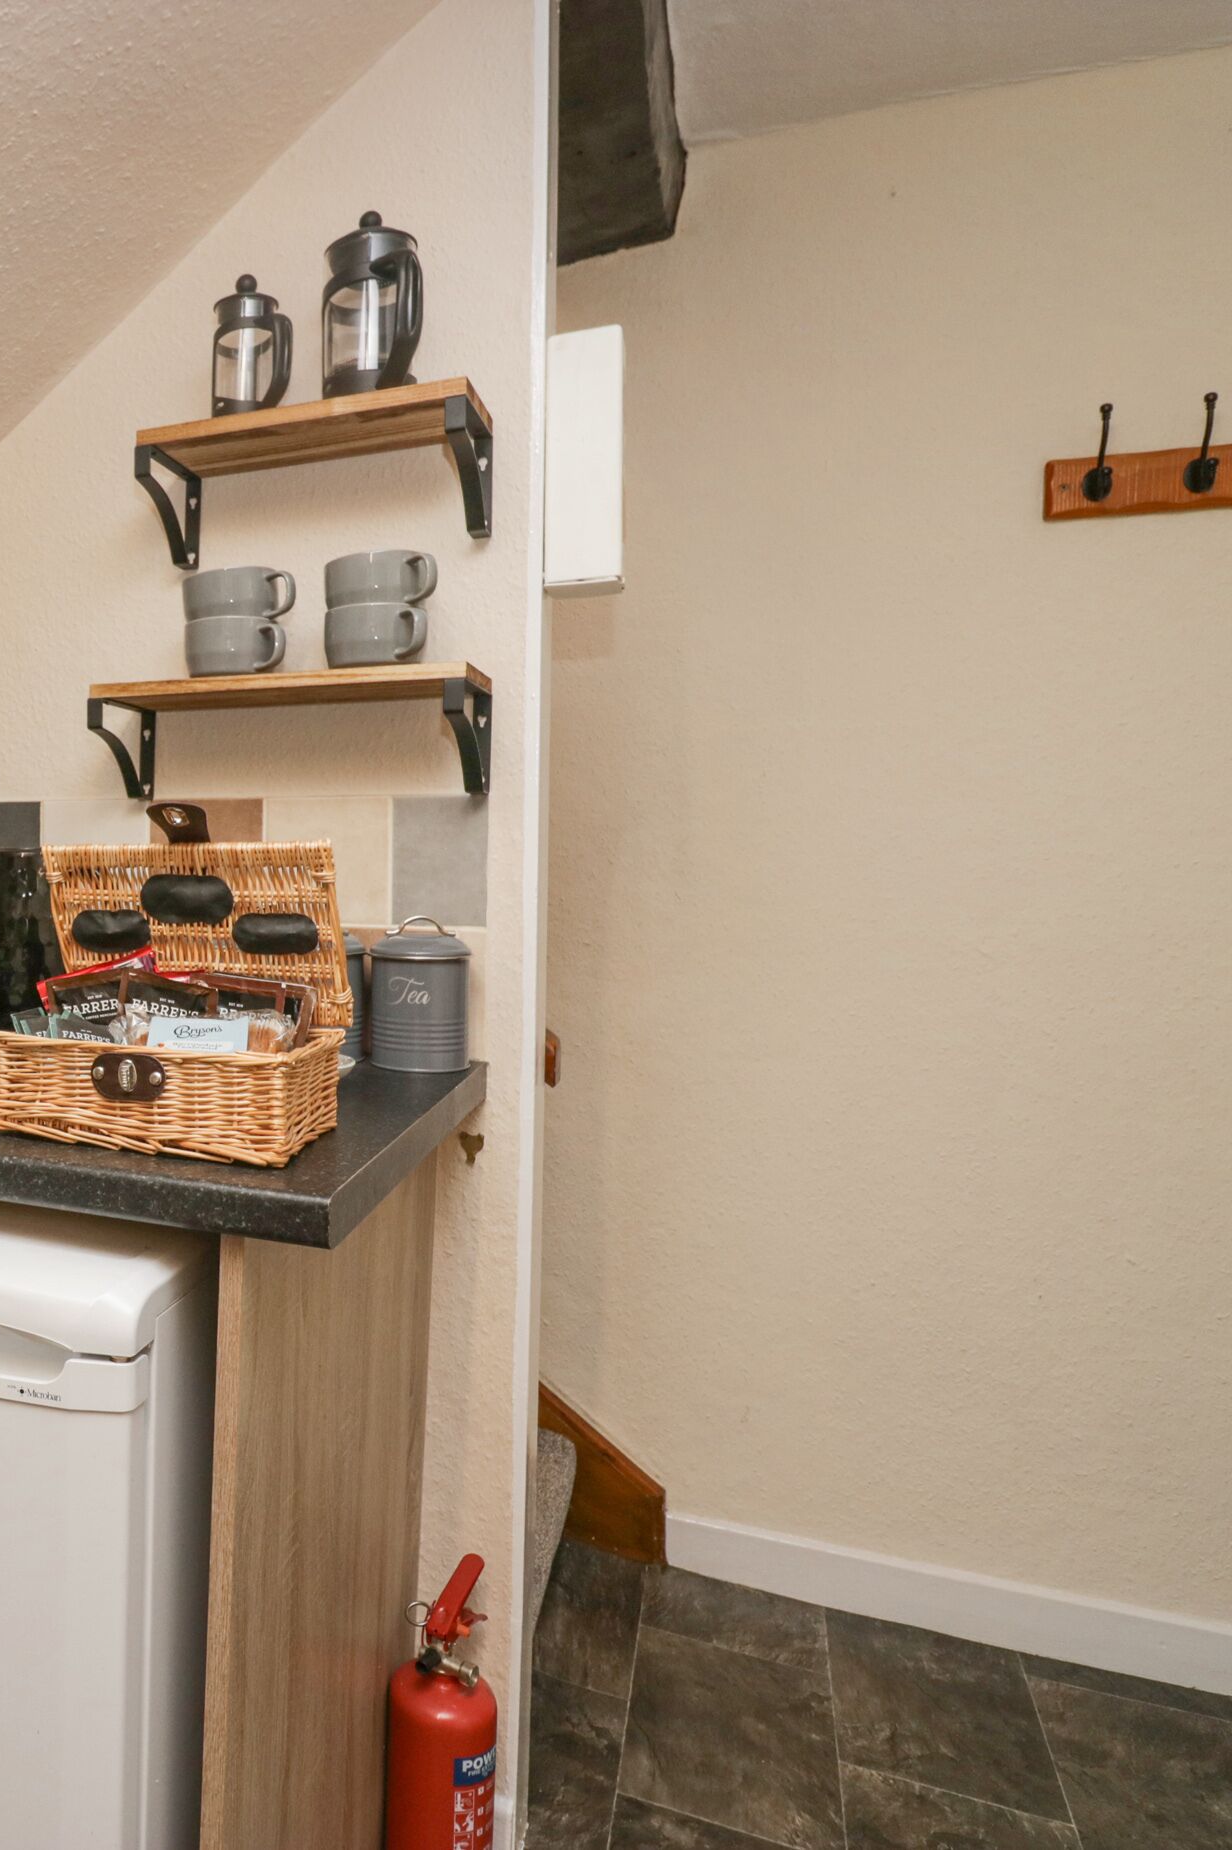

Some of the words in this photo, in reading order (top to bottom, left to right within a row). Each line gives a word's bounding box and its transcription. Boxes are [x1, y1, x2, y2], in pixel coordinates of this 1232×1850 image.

[388, 976, 431, 1005] Tea
[131, 998, 199, 1018] FARRER'S
[173, 1024, 223, 1039] Bryson's
[27, 1388, 62, 1402] Microban
